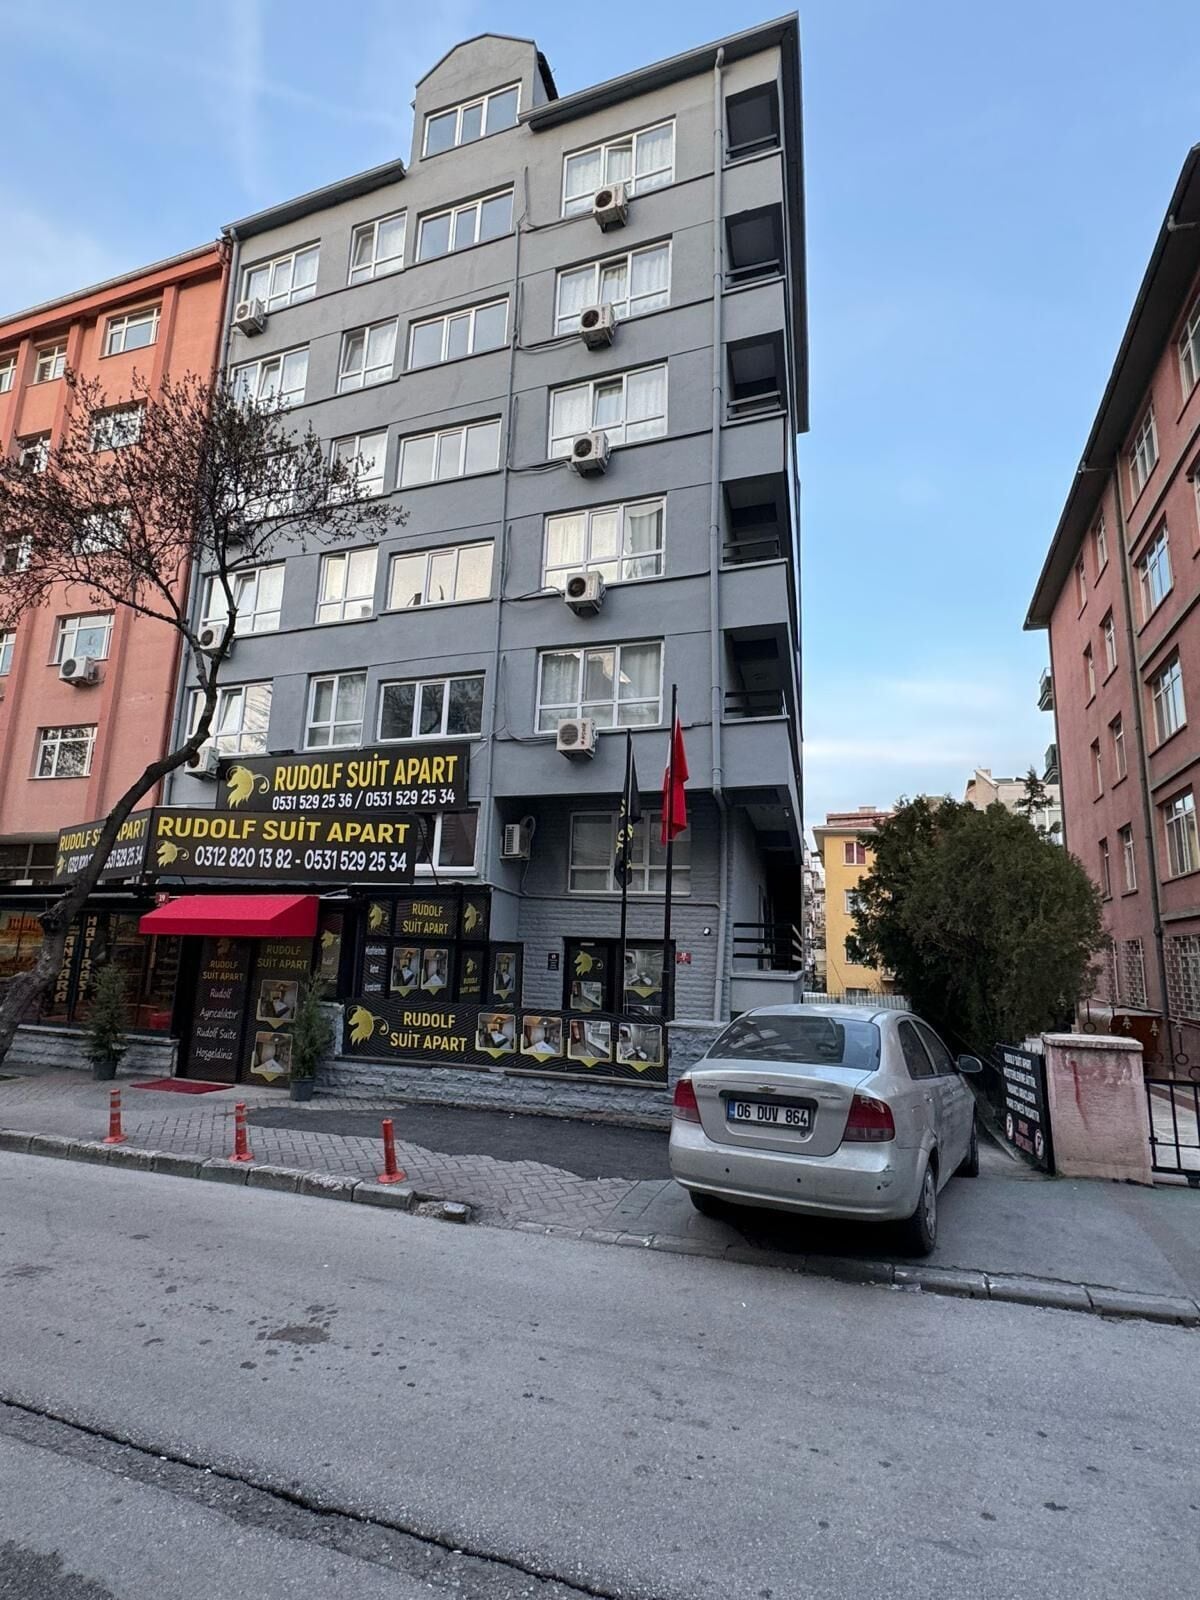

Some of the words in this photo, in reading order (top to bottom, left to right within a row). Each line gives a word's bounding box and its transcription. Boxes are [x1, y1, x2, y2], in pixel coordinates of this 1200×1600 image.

[274, 763, 343, 792] RUDOLF
[346, 753, 390, 788] SUİT
[393, 755, 458, 785] APART
[272, 796, 297, 811] 0531
[299, 794, 319, 809] 529
[321, 793, 337, 809] 25
[338, 792, 353, 808] 36
[354, 790, 364, 809] /
[365, 791, 392, 807] 0531
[395, 790, 418, 806] 529
[421, 789, 436, 805] 25
[439, 788, 456, 804] 34
[59, 830, 92, 852] RUDOLF
[117, 818, 148, 842] PART
[157, 816, 256, 840] RUDOLF
[262, 816, 321, 842] SUİT
[327, 822, 410, 844] APART
[194, 846, 227, 867] 0312
[229, 847, 255, 868] 820
[258, 848, 273, 868] 13
[275, 849, 293, 869] 82
[304, 849, 337, 870] 0531
[340, 850, 366, 871] 529
[368, 851, 386, 872] 25
[389, 852, 407, 872] 34
[412, 903, 443, 917] RUDOLF
[402, 918, 423, 933] SUİT
[423, 921, 449, 935] APART
[78, 915, 98, 1001] HATIRASI
[266, 944, 302, 955] RUDOLF
[54, 936, 75, 1003] ANKARA
[209, 960, 239, 969] RUDOLF
[279, 959, 309, 970] APART
[220, 972, 244, 981] APART
[210, 988, 233, 999] Rudolf
[403, 1011, 456, 1028] RUDOLF
[196, 1026, 219, 1038] Rudolf
[219, 1028, 237, 1040] Suite
[390, 1030, 420, 1048] SUİT
[423, 1035, 467, 1052] APART
[737, 1103, 751, 1119] 06
[757, 1105, 778, 1121] DUV
[785, 1109, 808, 1126] 864
